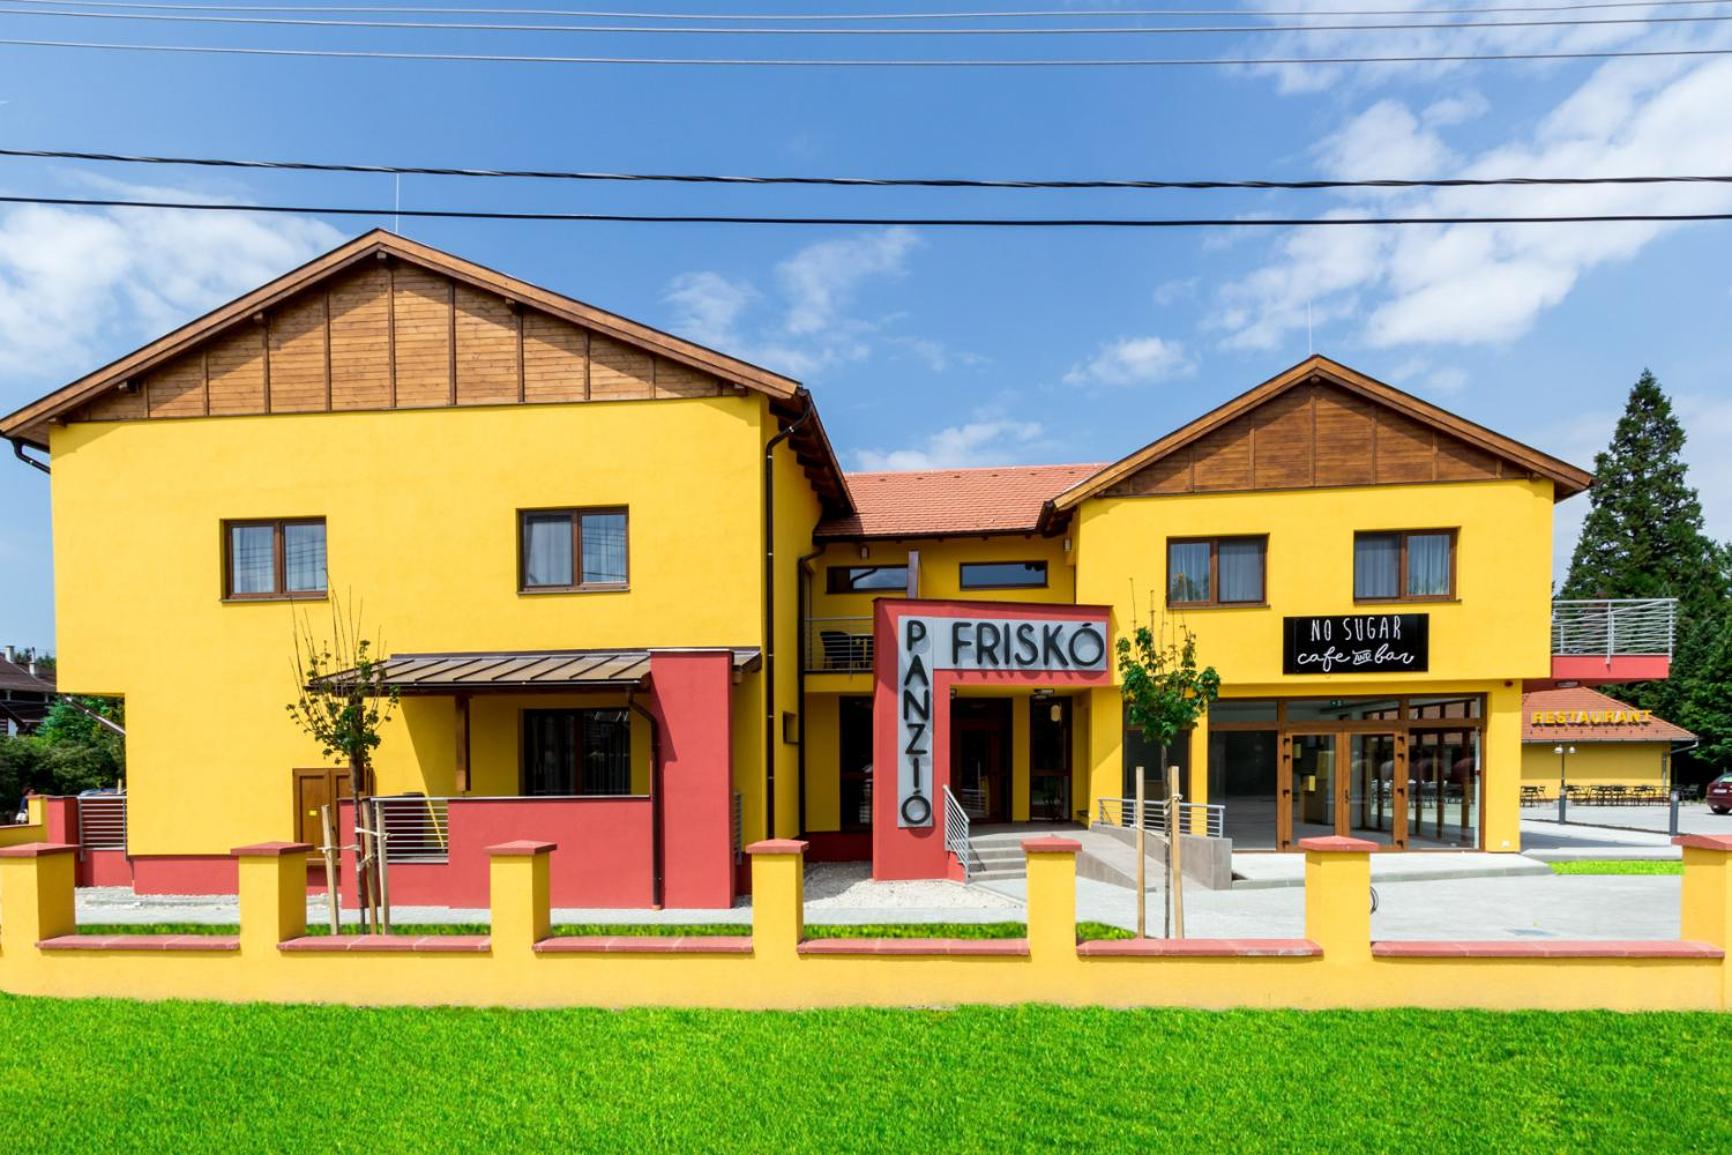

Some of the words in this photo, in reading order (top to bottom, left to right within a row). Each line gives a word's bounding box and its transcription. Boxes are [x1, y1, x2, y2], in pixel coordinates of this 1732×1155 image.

[1310, 618, 1332, 642] NO
[1342, 615, 1402, 642] SUGAR
[952, 621, 1105, 667] FRISKÓ
[1297, 645, 1351, 672] cafe
[1374, 643, 1415, 664] bar
[901, 619, 932, 825] PANZIÓ
[1532, 709, 1652, 726] RESTAURANT
